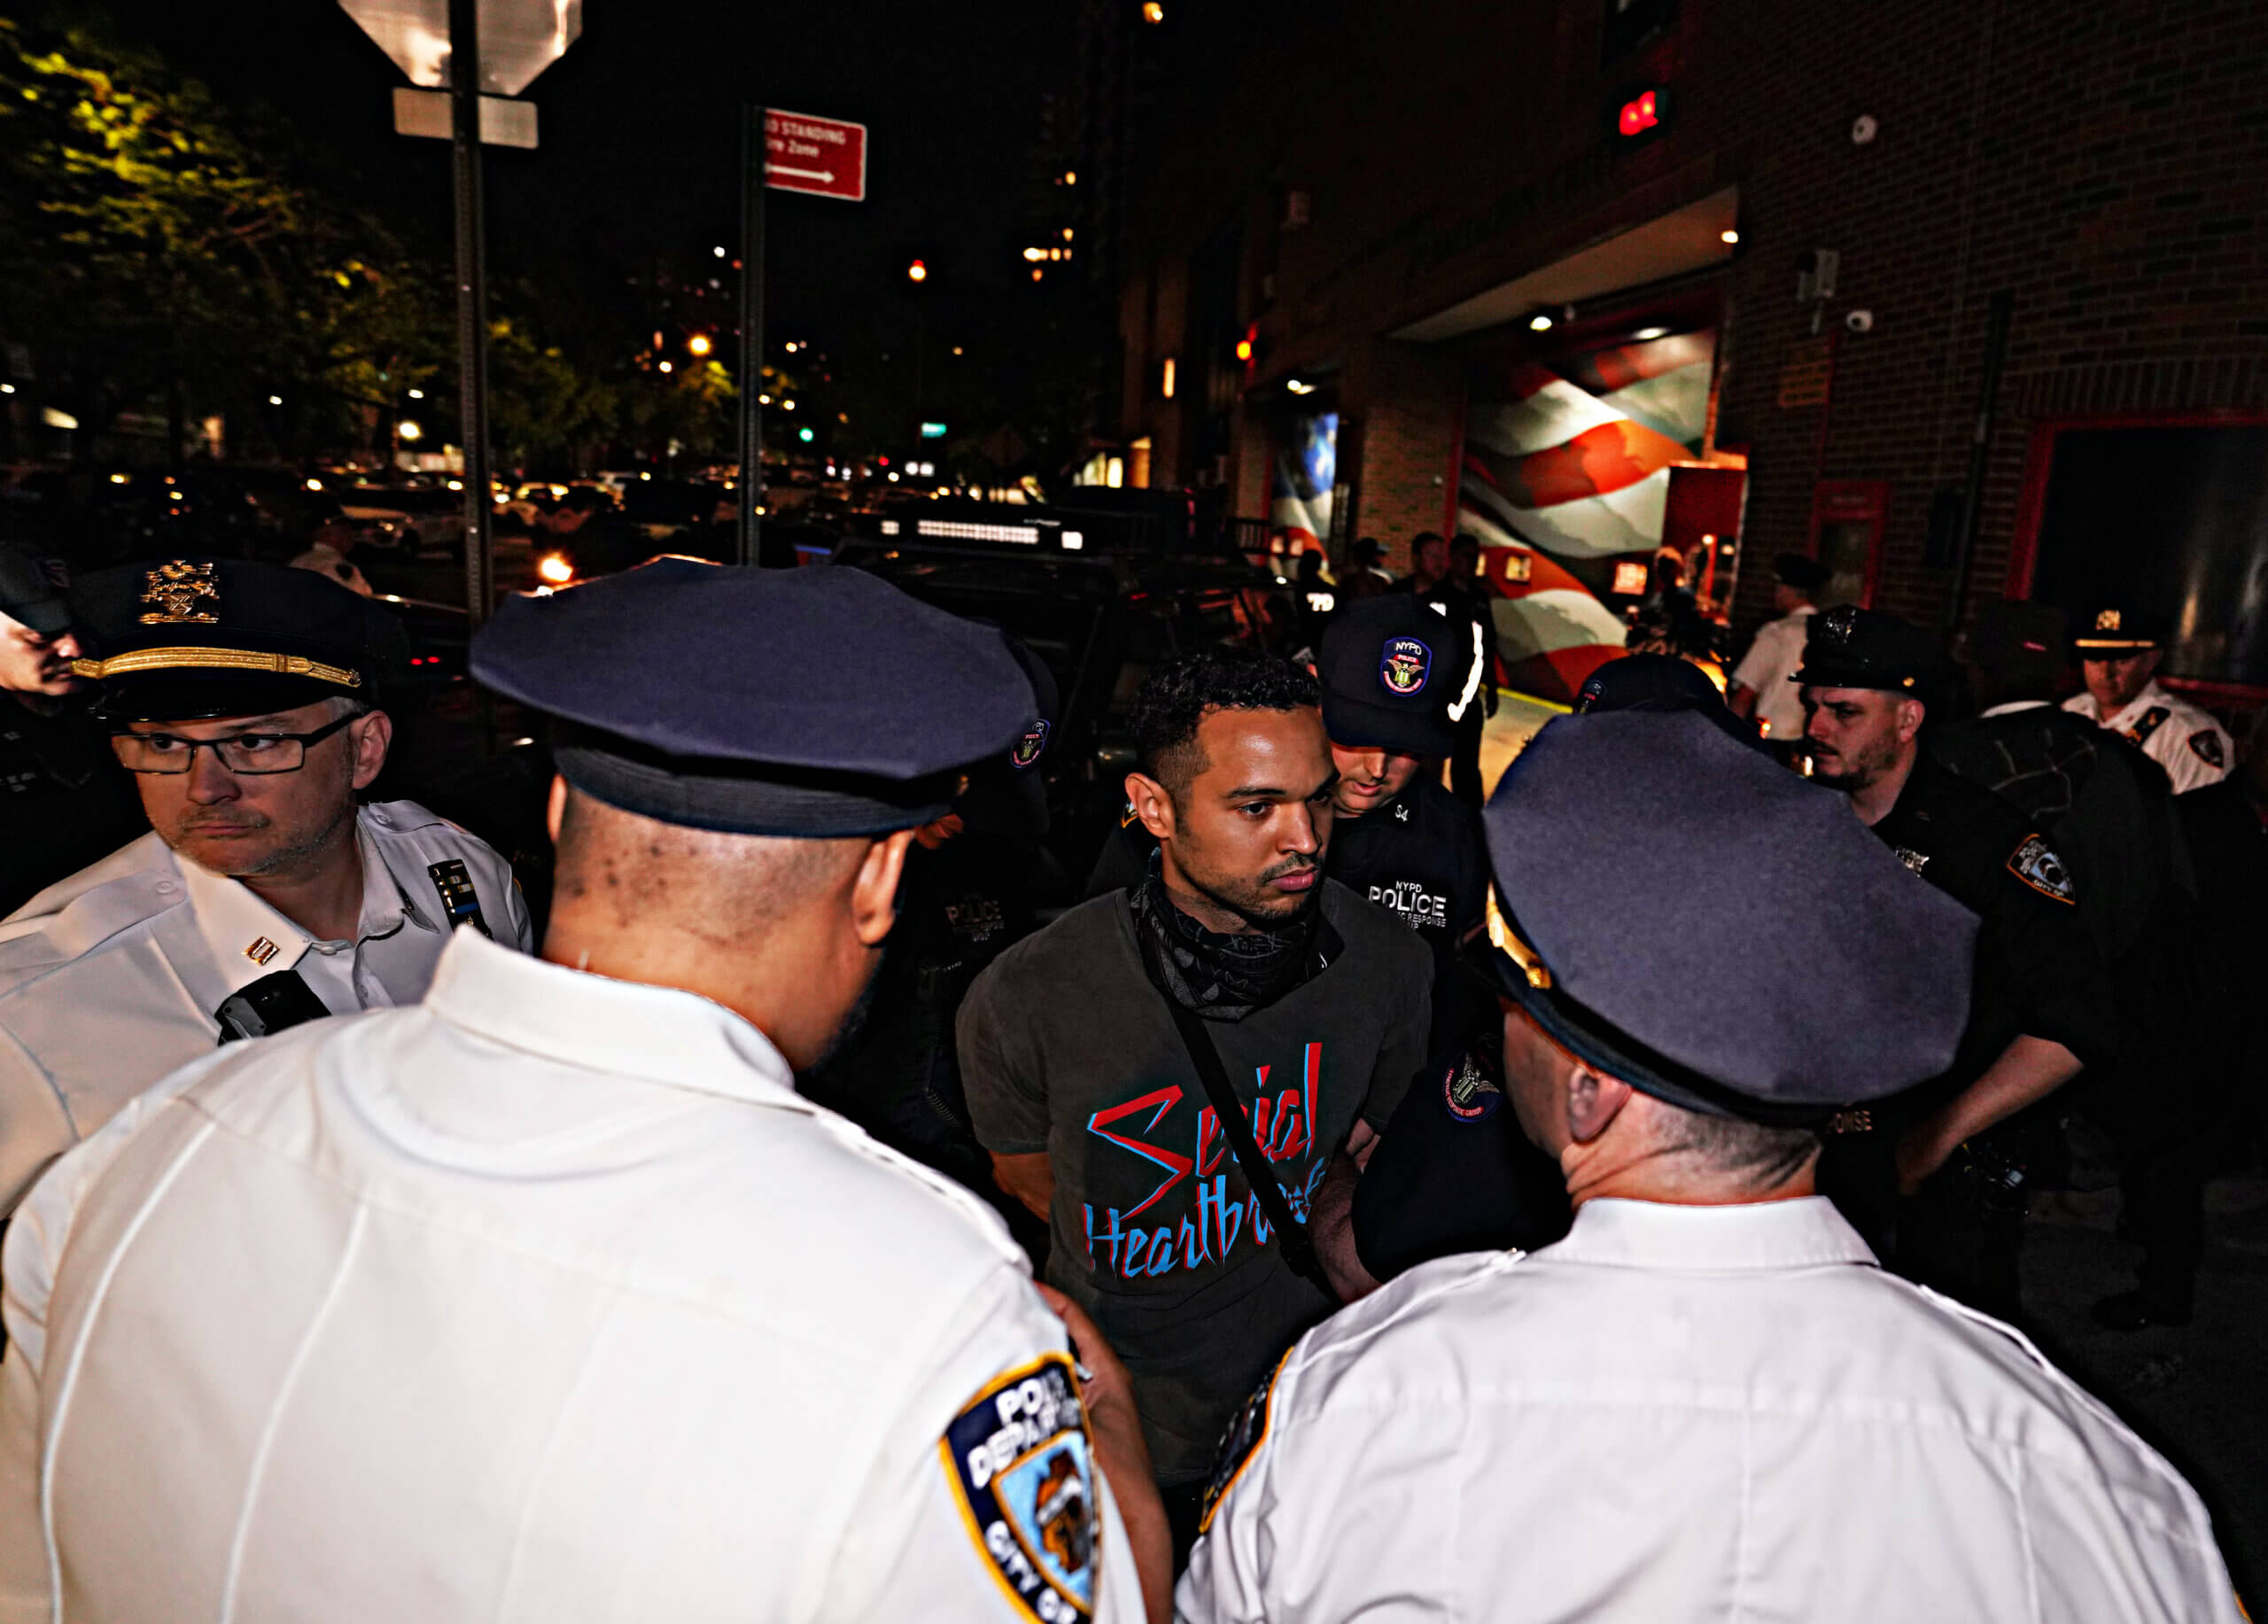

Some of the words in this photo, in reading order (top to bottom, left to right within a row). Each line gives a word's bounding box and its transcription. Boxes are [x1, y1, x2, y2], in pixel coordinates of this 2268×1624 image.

[781, 120, 846, 145] STANDING
[788, 139, 820, 159] Zone
[1395, 641, 1423, 656] NYPD
[1394, 804, 1409, 822] S4
[1395, 880, 1423, 893] NYPD
[1368, 885, 1447, 918] POLICE
[1407, 913, 1447, 928] RESPONSE
[985, 1519, 1042, 1593] CITY
[1037, 1587, 1077, 1624] OF
